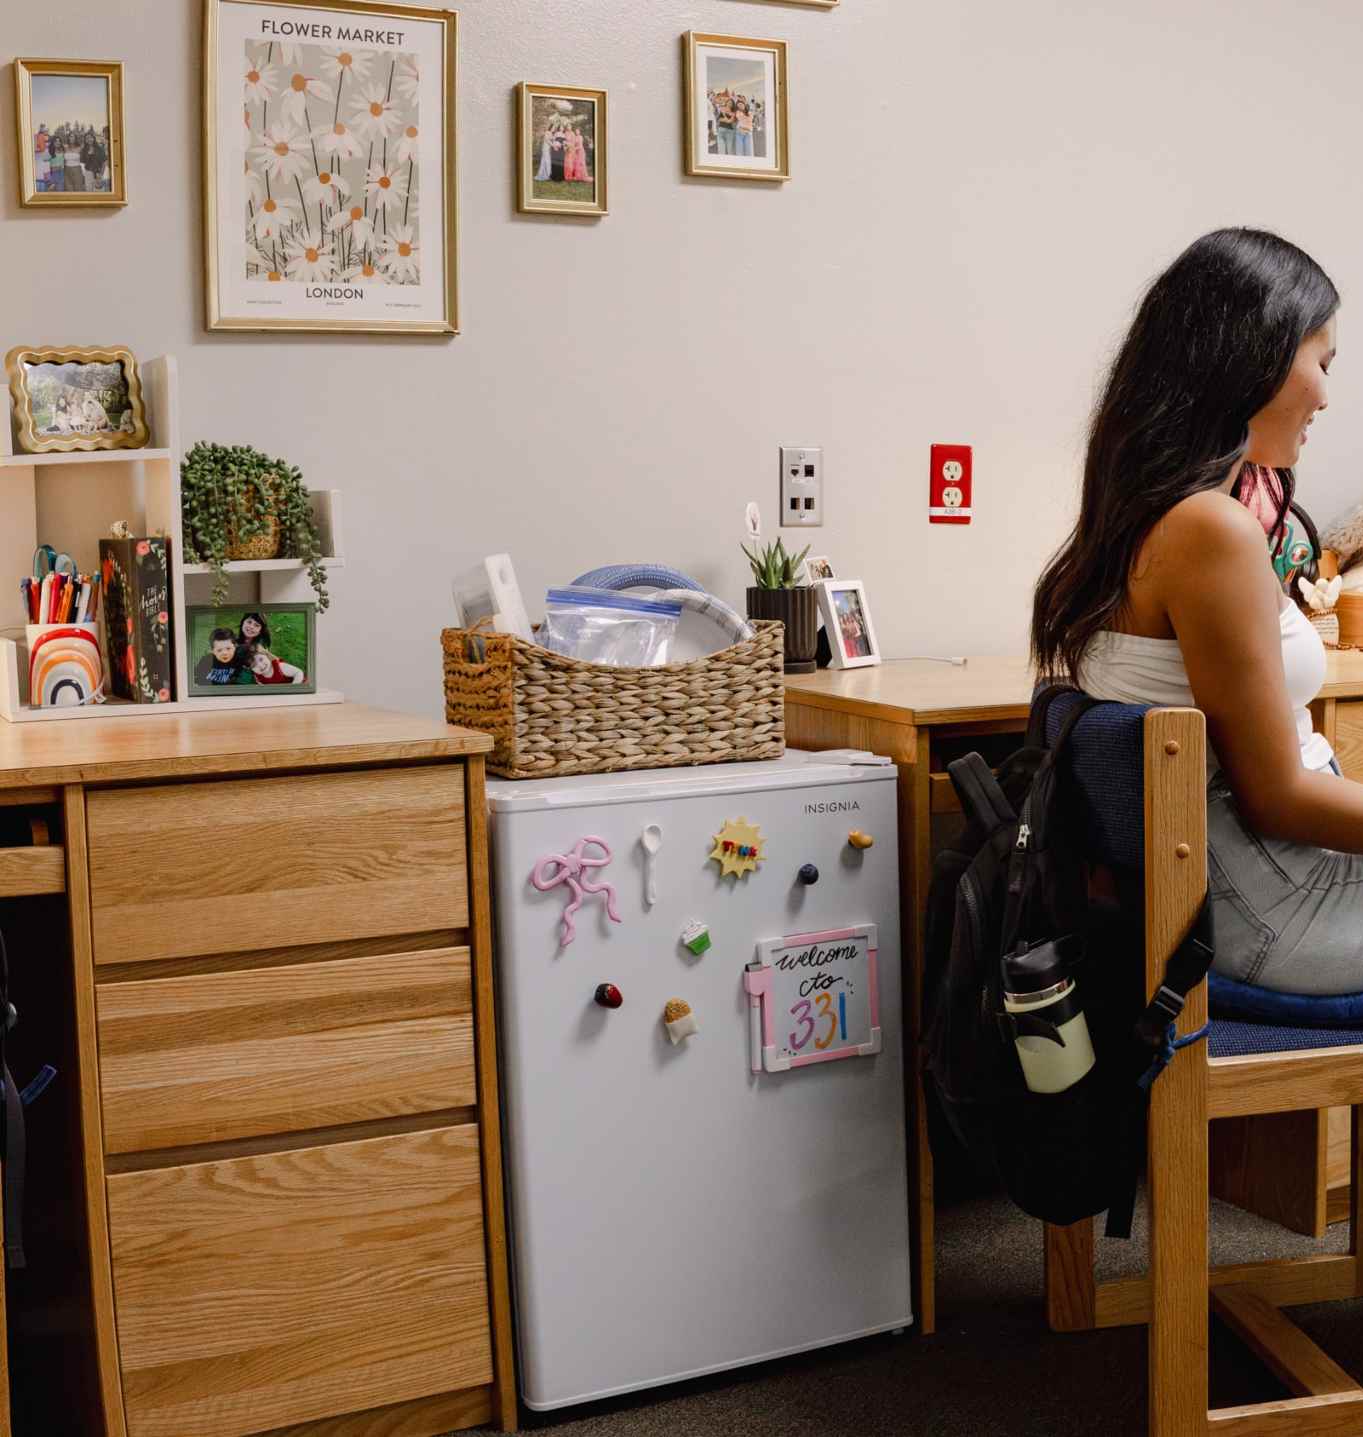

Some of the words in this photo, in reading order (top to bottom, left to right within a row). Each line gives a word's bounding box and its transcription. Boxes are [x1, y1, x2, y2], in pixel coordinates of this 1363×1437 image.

[261, 19, 333, 39] FLOWER
[337, 26, 405, 46] MARKET
[305, 286, 365, 300] LONDON
[804, 801, 861, 814] INSIGNIA
[776, 945, 859, 971] welcome
[789, 991, 848, 1051] 331
